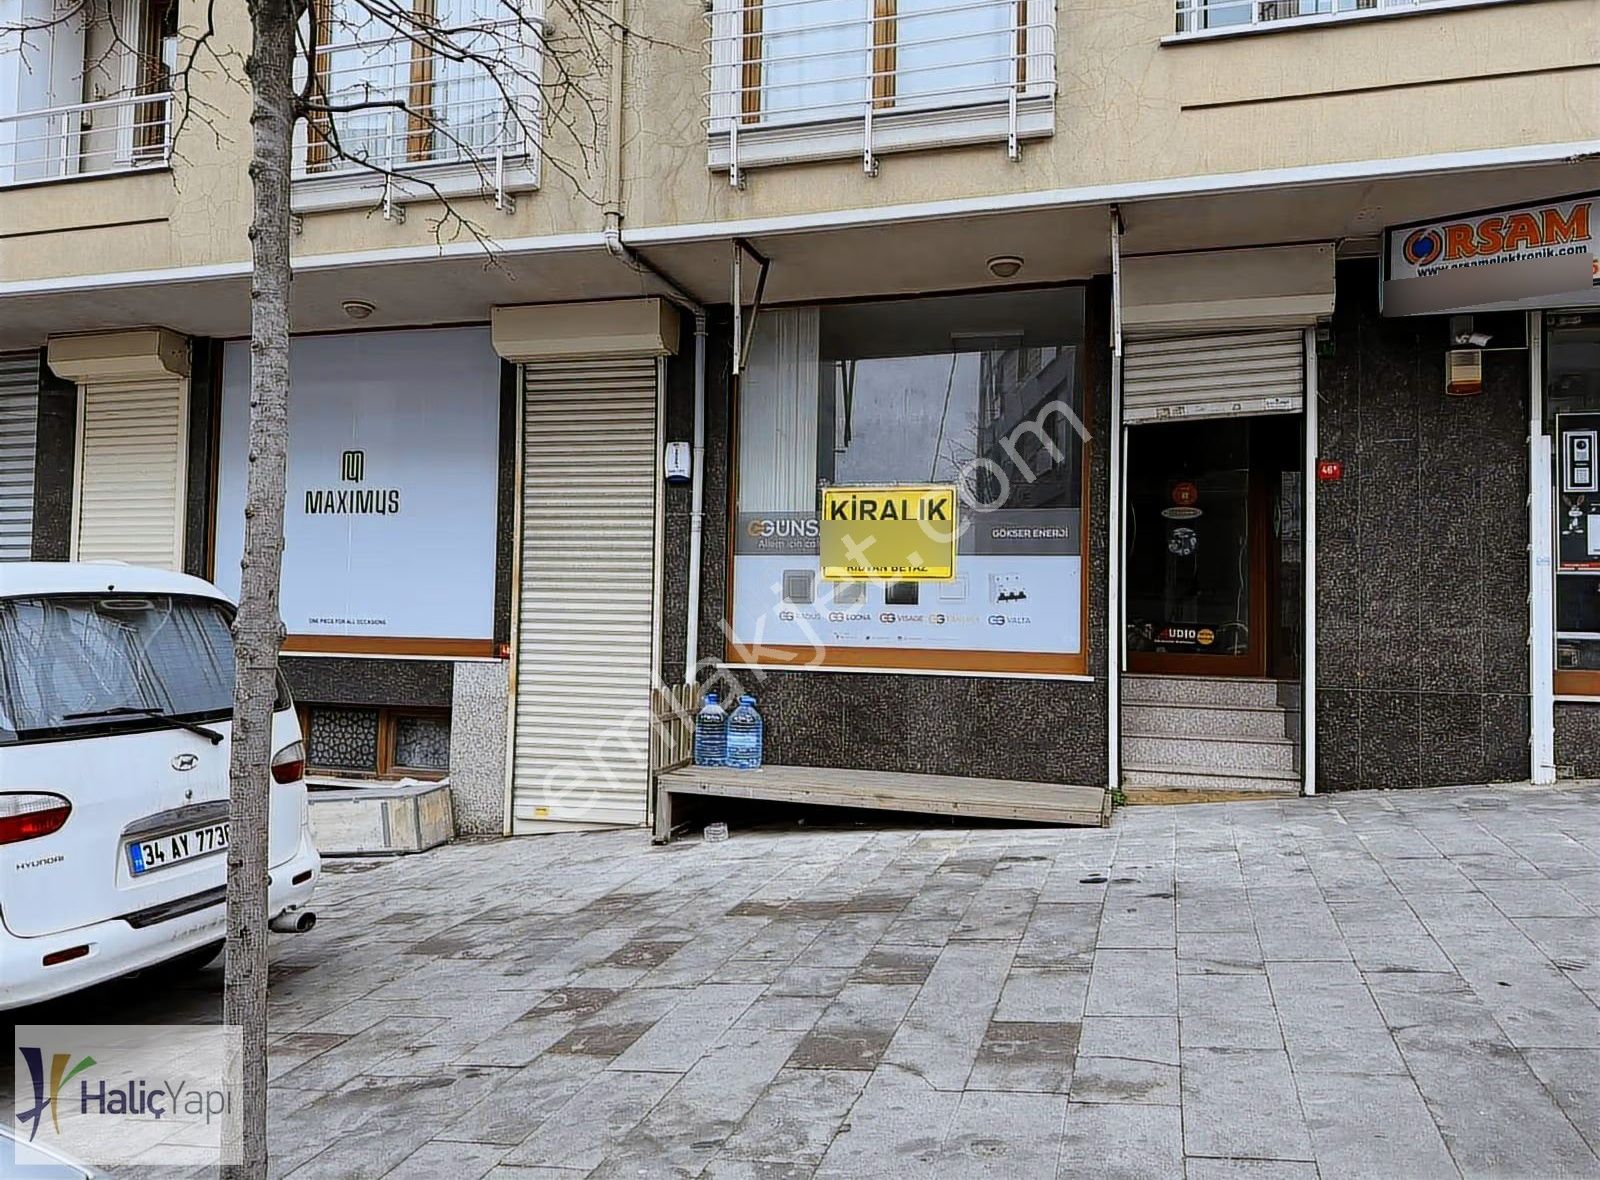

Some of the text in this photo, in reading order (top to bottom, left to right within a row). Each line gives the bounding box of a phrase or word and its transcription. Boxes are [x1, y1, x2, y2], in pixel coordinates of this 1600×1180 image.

[1403, 203, 1592, 266] ORSAM
[305, 490, 400, 515] MAXIMUS
[831, 495, 947, 520] KİRALIK
[759, 519, 821, 537] GÜNS
[143, 842, 165, 866] 34
[171, 834, 189, 859] AY
